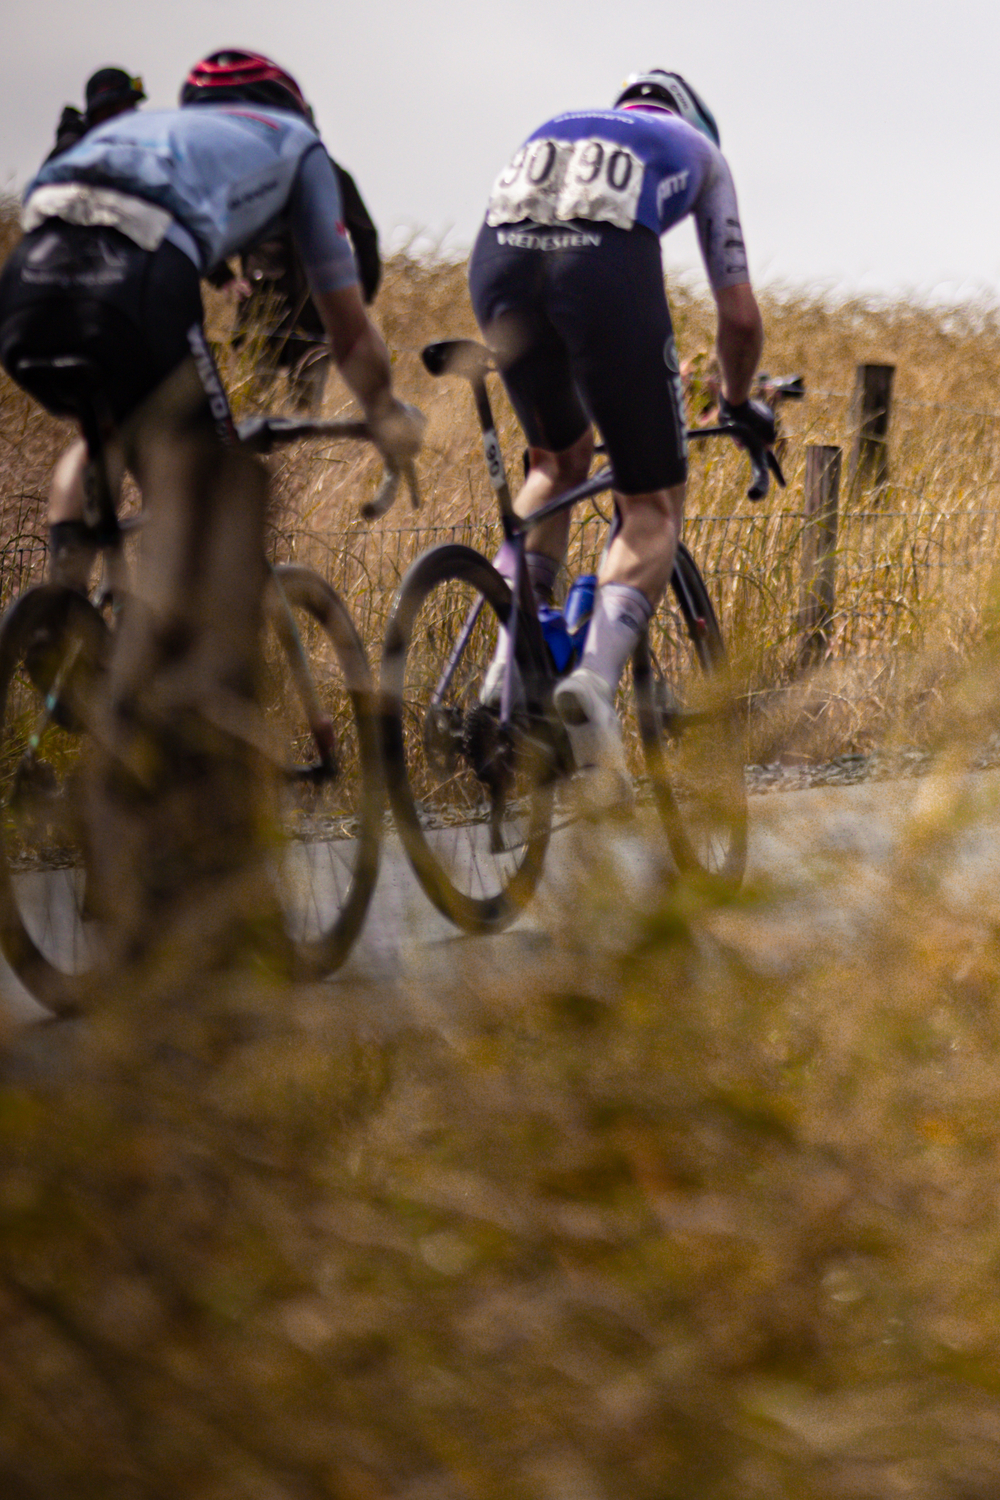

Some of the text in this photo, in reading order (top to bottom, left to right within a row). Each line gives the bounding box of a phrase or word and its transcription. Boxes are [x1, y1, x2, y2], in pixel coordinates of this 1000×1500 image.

[499, 141, 556, 188] 90
[576, 142, 632, 192] 90
[486, 444, 499, 477] 90
